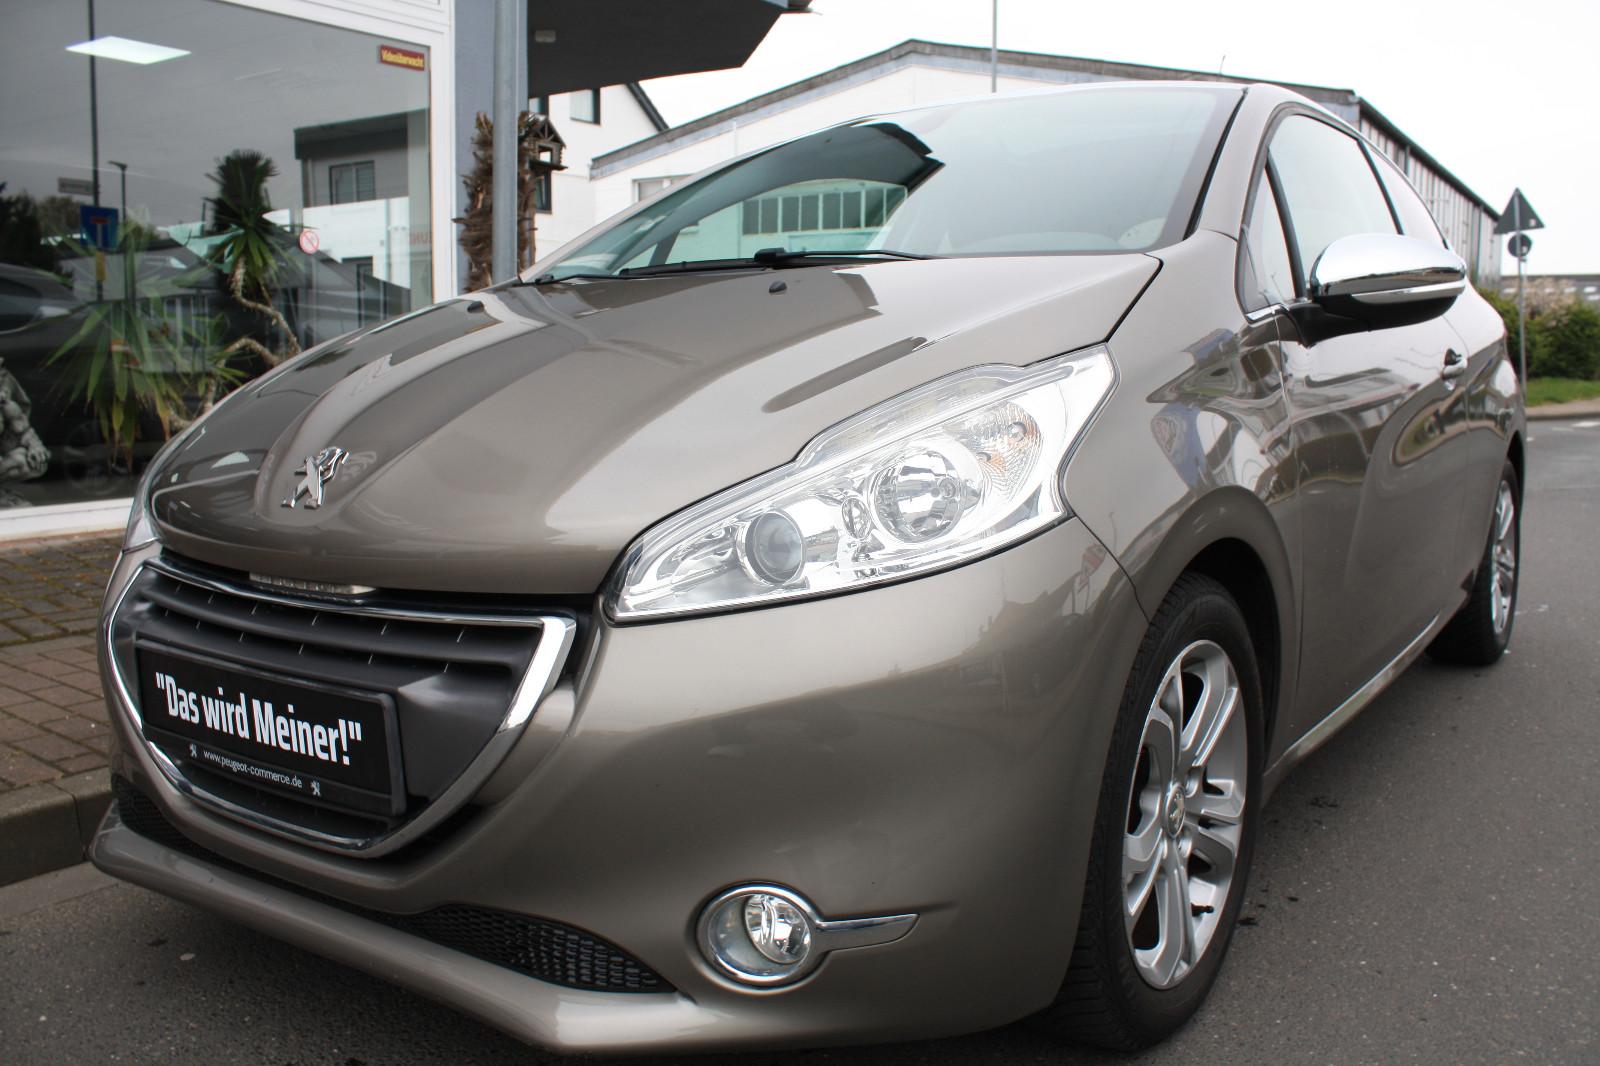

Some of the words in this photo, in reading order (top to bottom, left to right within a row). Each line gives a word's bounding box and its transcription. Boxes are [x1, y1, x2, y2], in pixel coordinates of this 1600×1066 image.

[155, 671, 200, 725] "Das
[201, 686, 250, 740] wird
[252, 698, 362, 766] Meiner!"
[203, 750, 303, 790] www.peugeot-commerce.de
